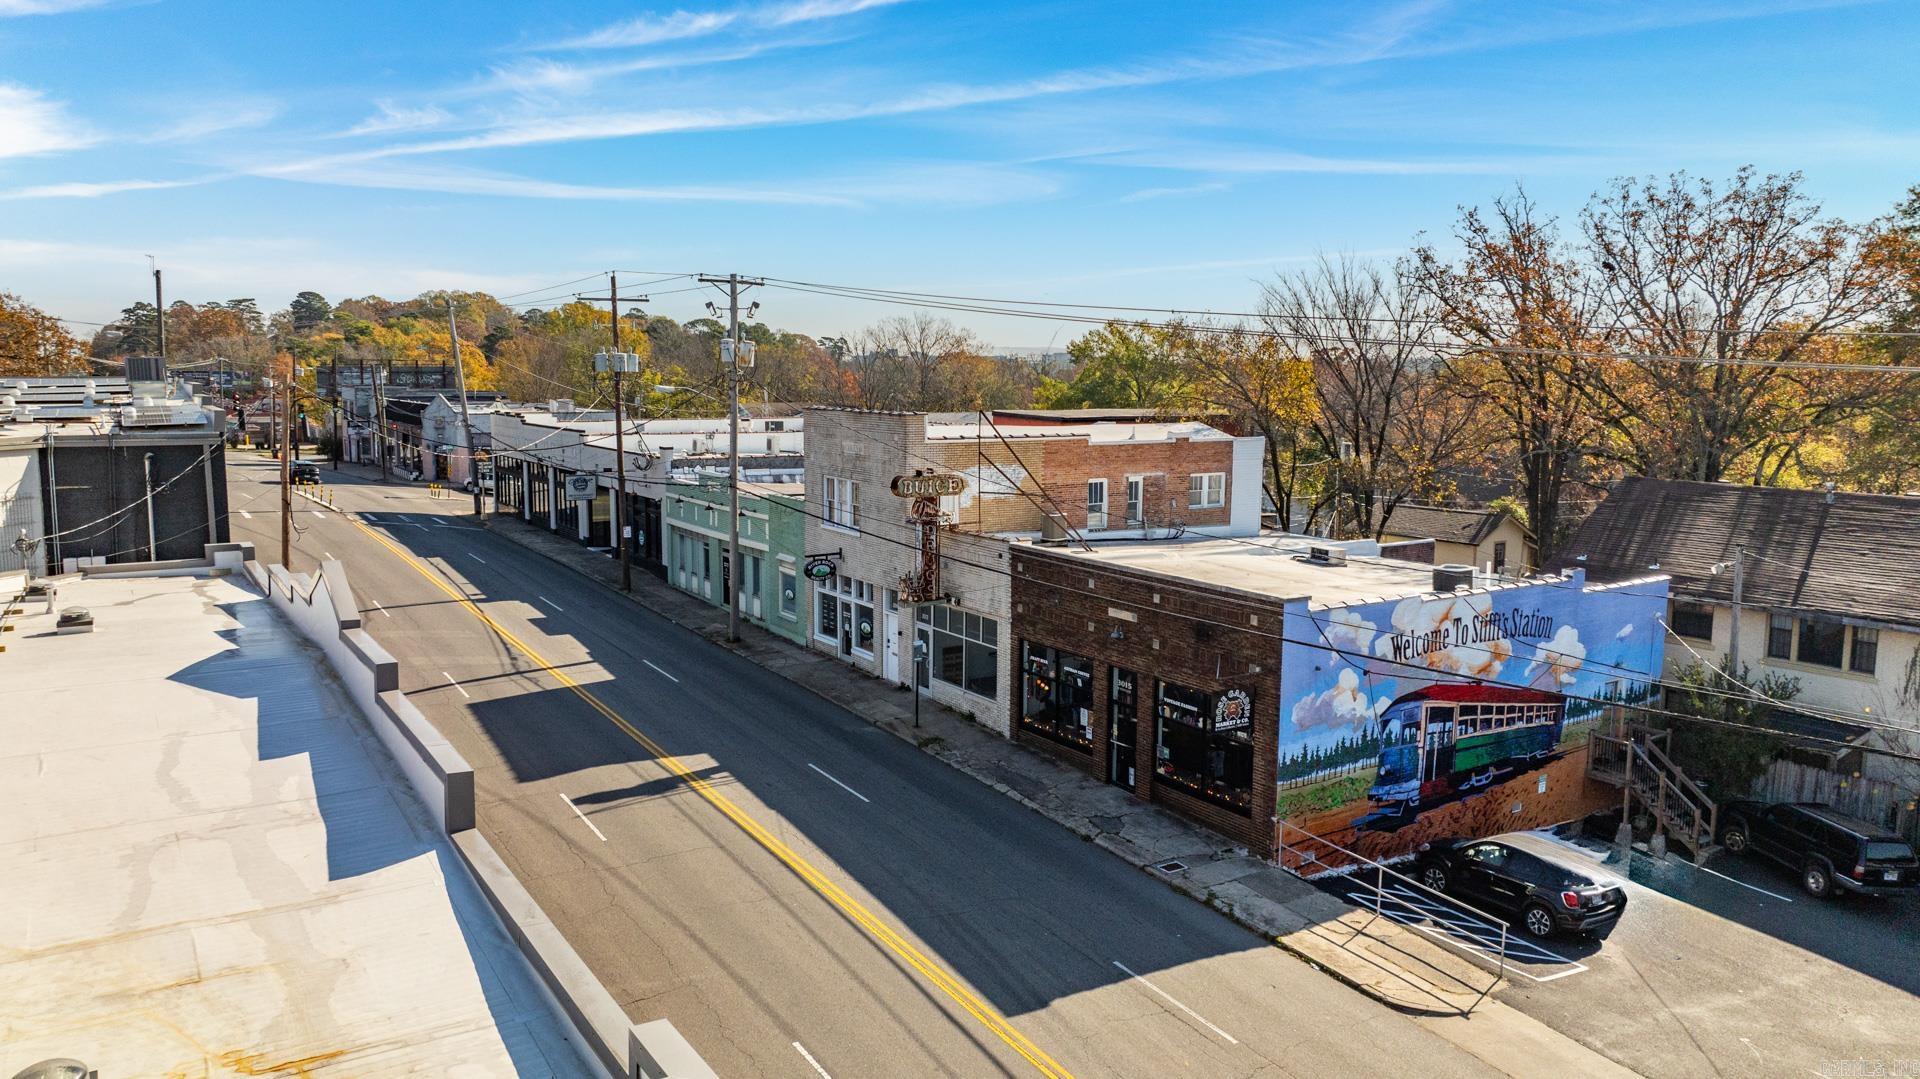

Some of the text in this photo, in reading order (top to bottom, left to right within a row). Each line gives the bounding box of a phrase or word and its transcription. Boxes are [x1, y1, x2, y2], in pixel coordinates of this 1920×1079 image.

[903, 478, 959, 494] BUICE
[1391, 608, 1553, 662] Welcome To Stifft's Station
[1216, 689, 1250, 722] ROSE GARDEN
[1215, 719, 1236, 728] MARKET
